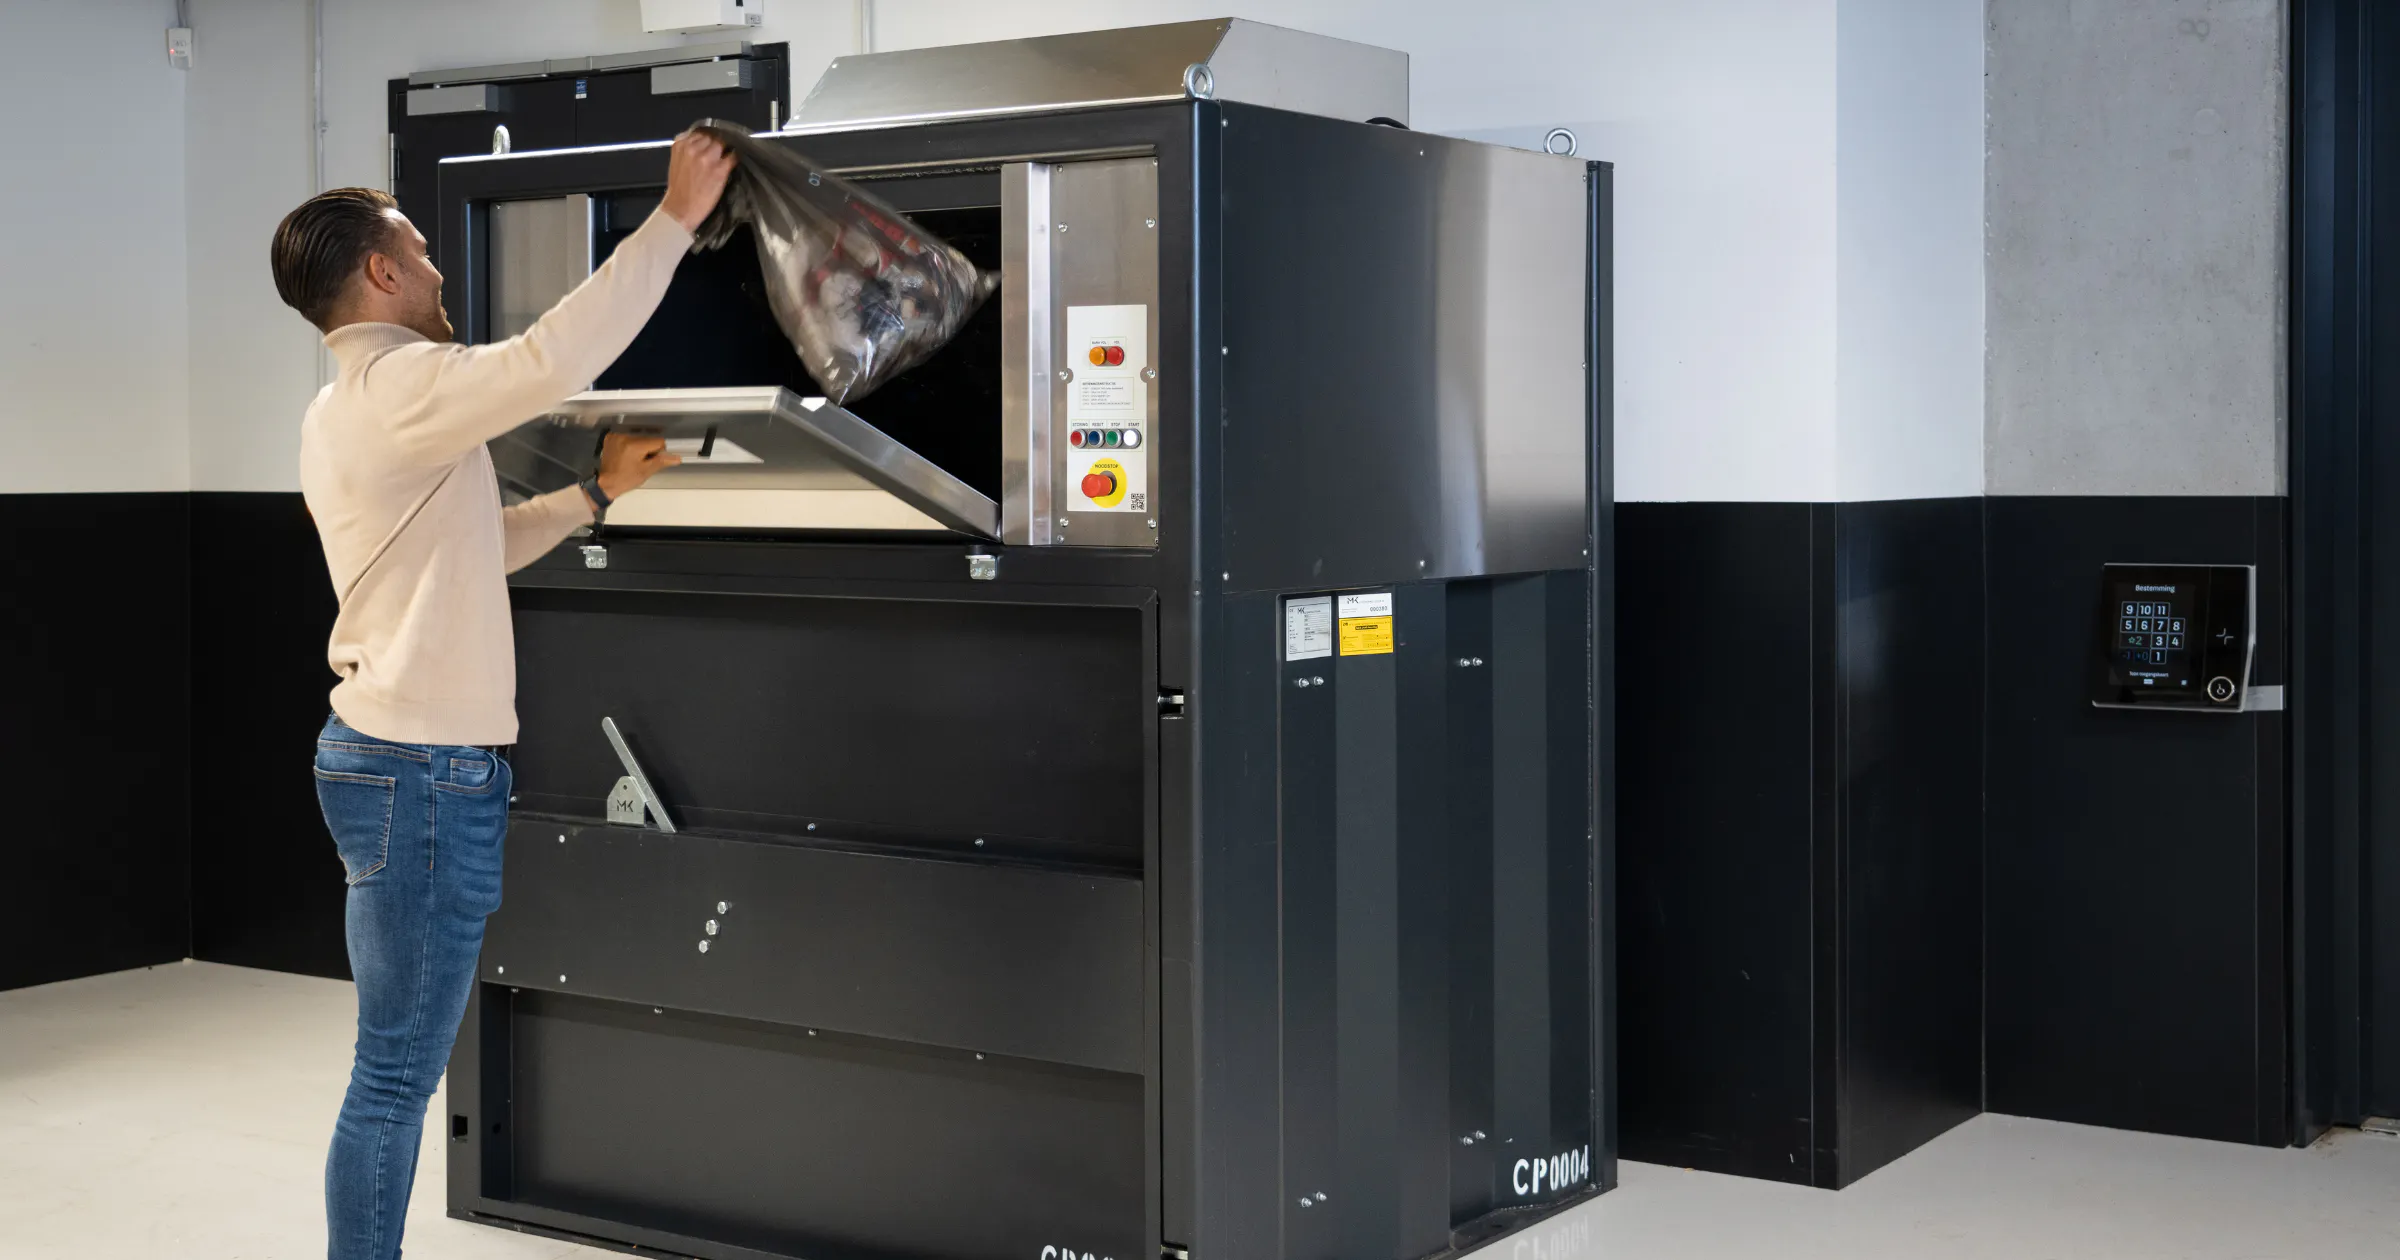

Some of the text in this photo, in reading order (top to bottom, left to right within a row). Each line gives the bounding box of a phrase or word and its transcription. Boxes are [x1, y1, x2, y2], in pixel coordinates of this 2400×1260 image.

[2135, 584, 2176, 594] Bestemming
[1347, 596, 1359, 604] MK
[2126, 605, 2166, 615] 9 10 11
[2125, 620, 2180, 631] 5 6 7 8
[2135, 636, 2179, 646] 2 3 4
[2156, 652, 2161, 661] 1
[616, 799, 634, 812] MK
[1512, 1144, 1589, 1196] CP0004
